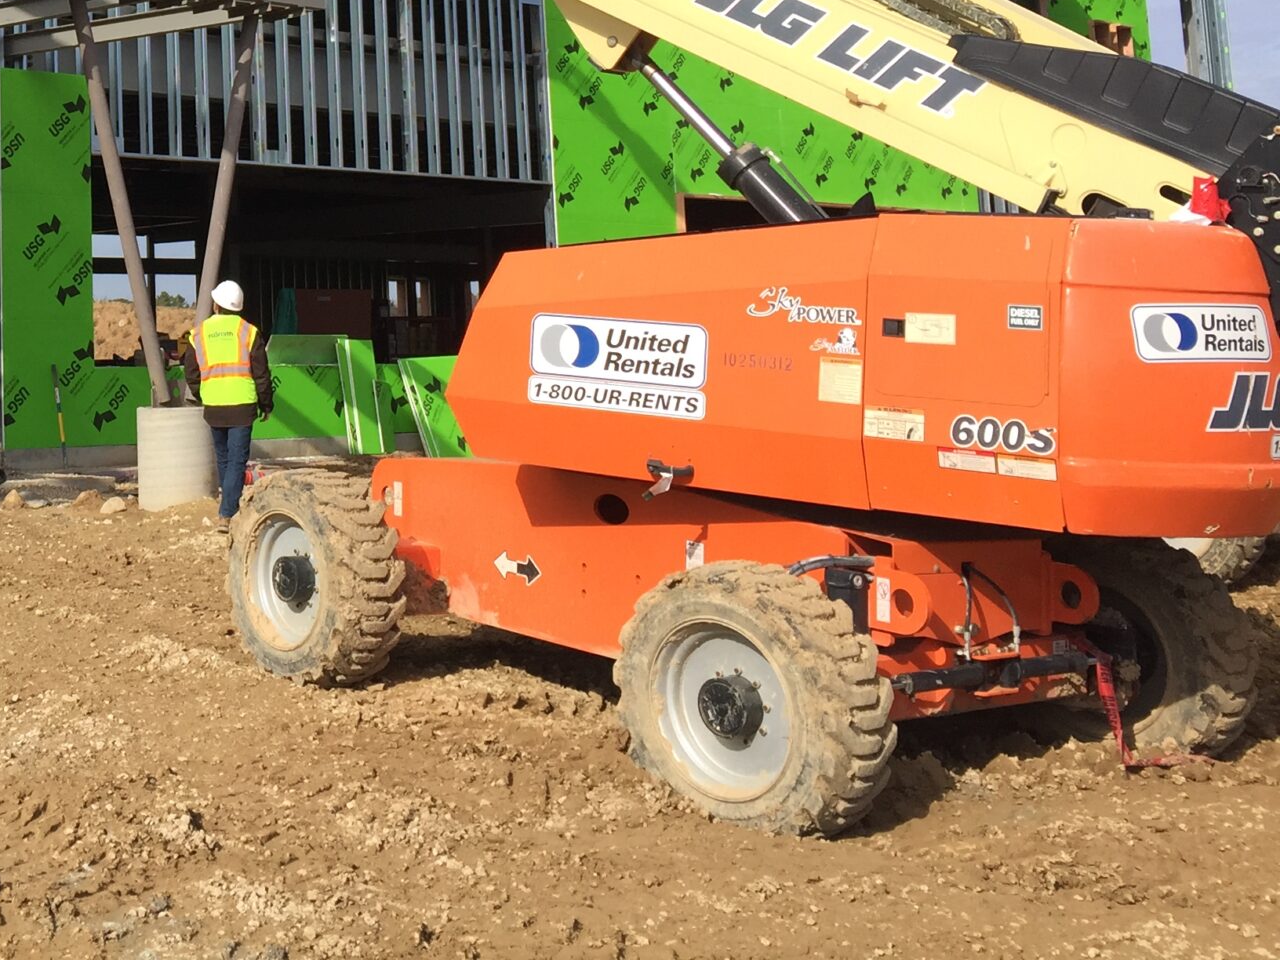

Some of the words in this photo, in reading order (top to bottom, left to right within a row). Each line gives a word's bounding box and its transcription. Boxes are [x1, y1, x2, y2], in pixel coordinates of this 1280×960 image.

[555, 53, 570, 73] USG
[673, 53, 686, 72] USG
[817, 24, 988, 112] LIFT
[589, 77, 603, 96] USG
[48, 112, 71, 137] USG
[3, 132, 25, 158] USG
[795, 136, 807, 155] USG
[601, 155, 615, 176] USG
[699, 149, 712, 168] USG
[568, 172, 583, 193] USG
[633, 176, 647, 197] USG
[22, 234, 45, 260] USG
[72, 260, 92, 286] USG
[797, 307, 857, 323] POWER
[1010, 308, 1040, 318] DIESEL
[1201, 314, 1256, 332] United
[606, 328, 690, 354] United
[1205, 334, 1265, 352] Rentals
[59, 360, 82, 387] USG
[604, 352, 695, 379] Rentals
[7, 386, 30, 413] USG
[109, 384, 130, 410] USG
[534, 383, 699, 413] 1-800-UR-RENTS
[1209, 374, 1280, 429] JL
[951, 415, 1056, 454] 600S
